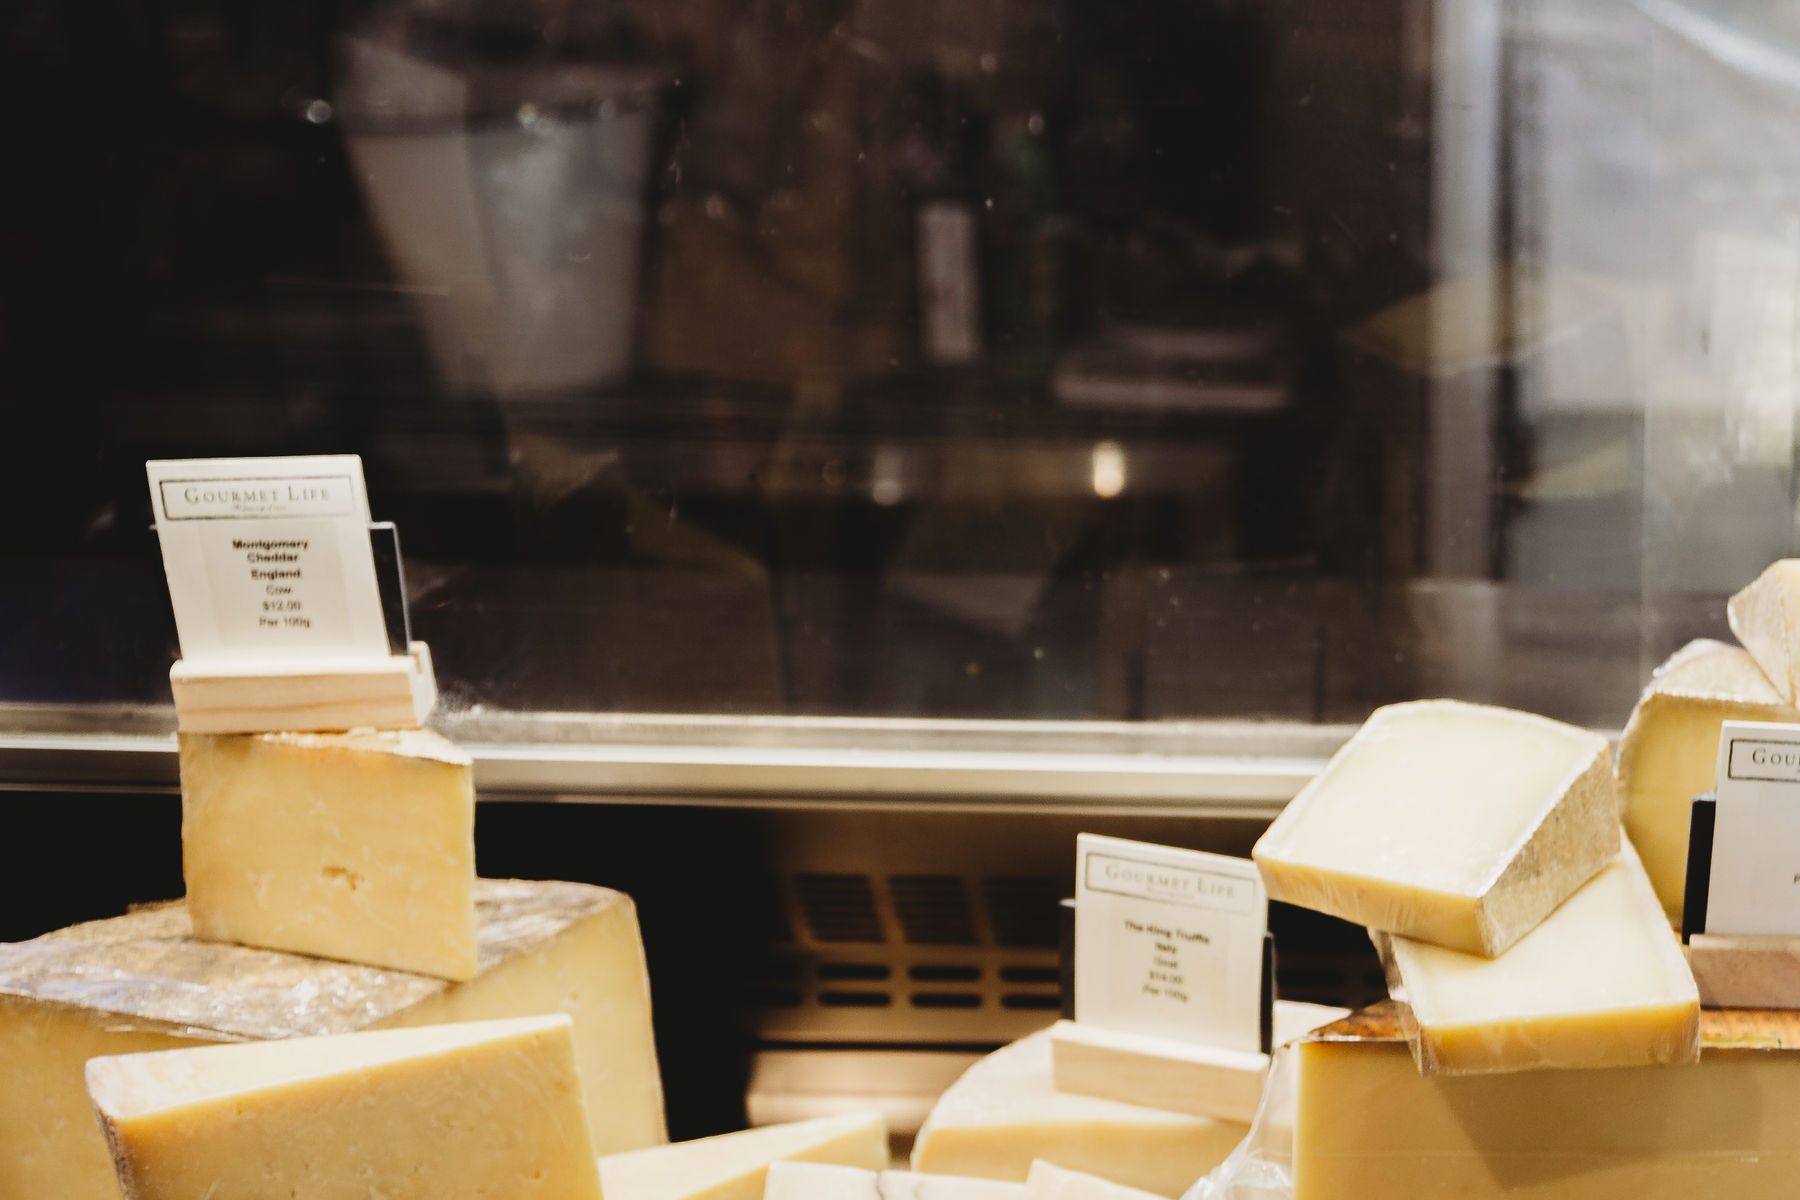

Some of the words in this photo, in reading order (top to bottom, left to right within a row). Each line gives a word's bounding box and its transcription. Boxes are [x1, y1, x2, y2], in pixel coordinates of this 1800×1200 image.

[247, 553, 299, 562] Cheddar
[251, 569, 301, 580] England
[266, 586, 292, 595] Cow
[259, 617, 278, 627] Per
[283, 616, 311, 629] 100g
